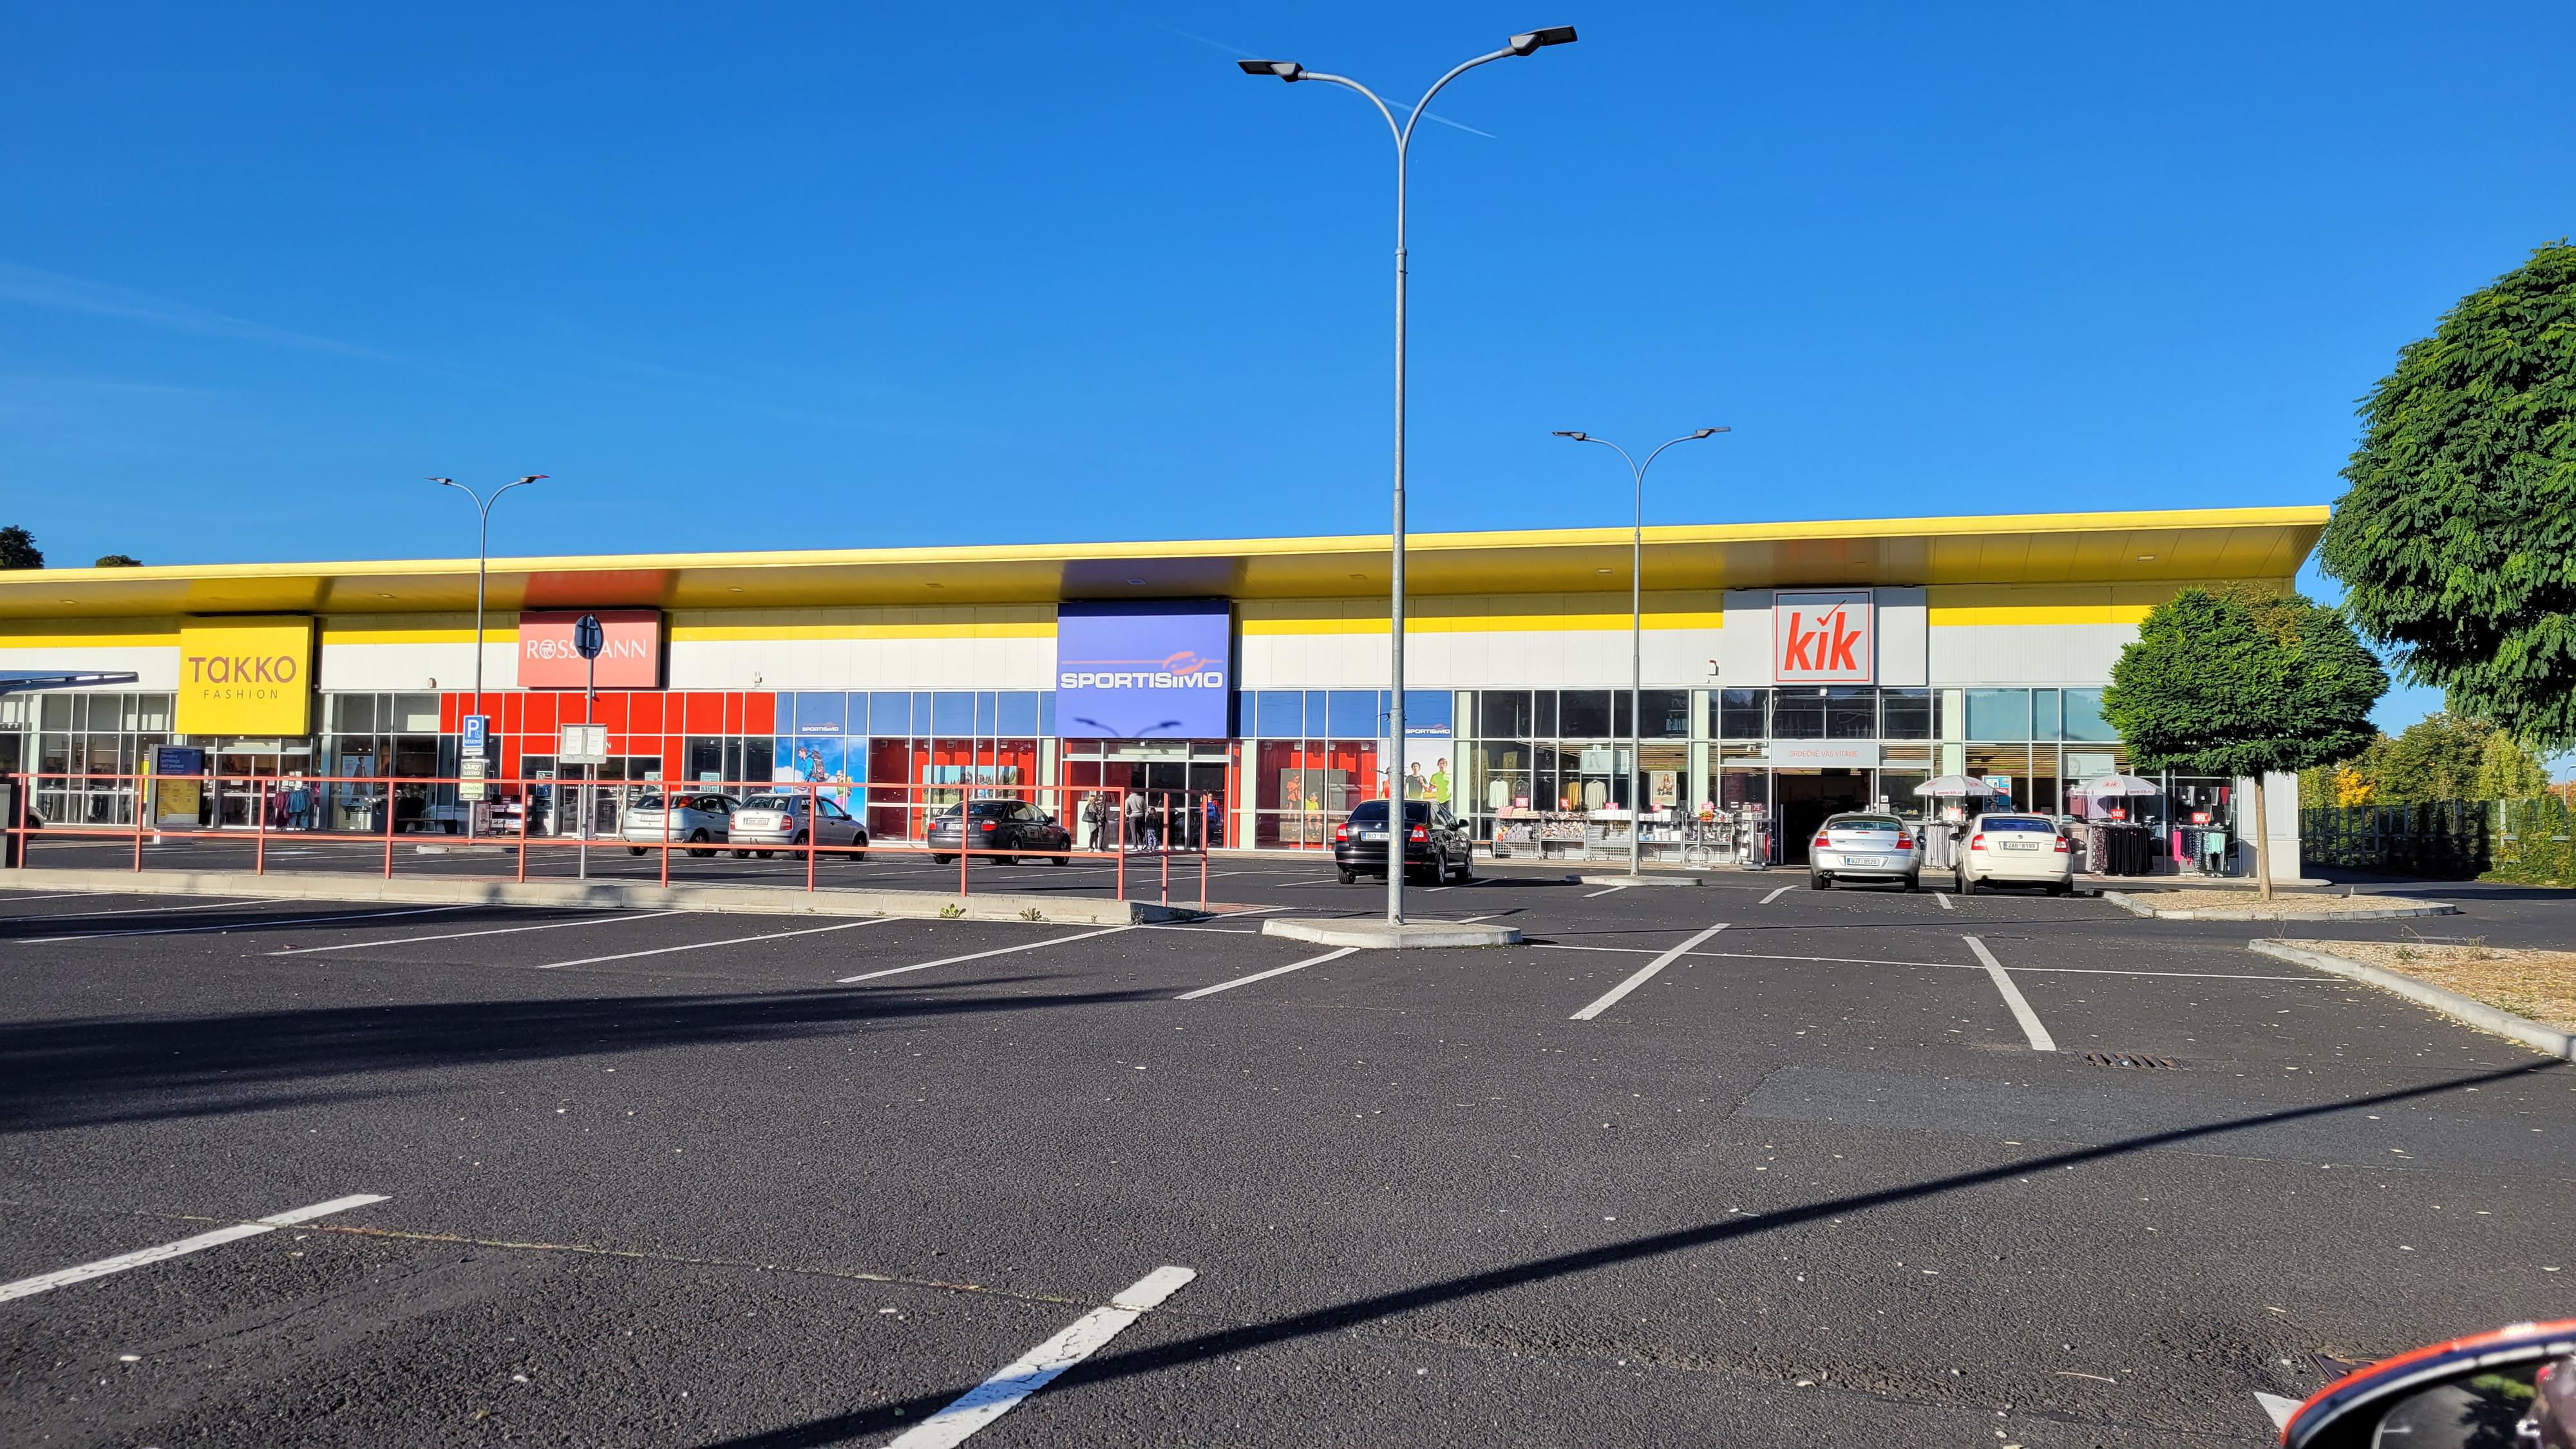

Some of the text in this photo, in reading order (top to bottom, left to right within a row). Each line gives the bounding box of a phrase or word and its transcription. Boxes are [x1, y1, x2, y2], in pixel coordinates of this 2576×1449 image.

[526, 639, 646, 659] ROSSANN
[204, 690, 278, 699] FASHION
[468, 719, 479, 737] P
